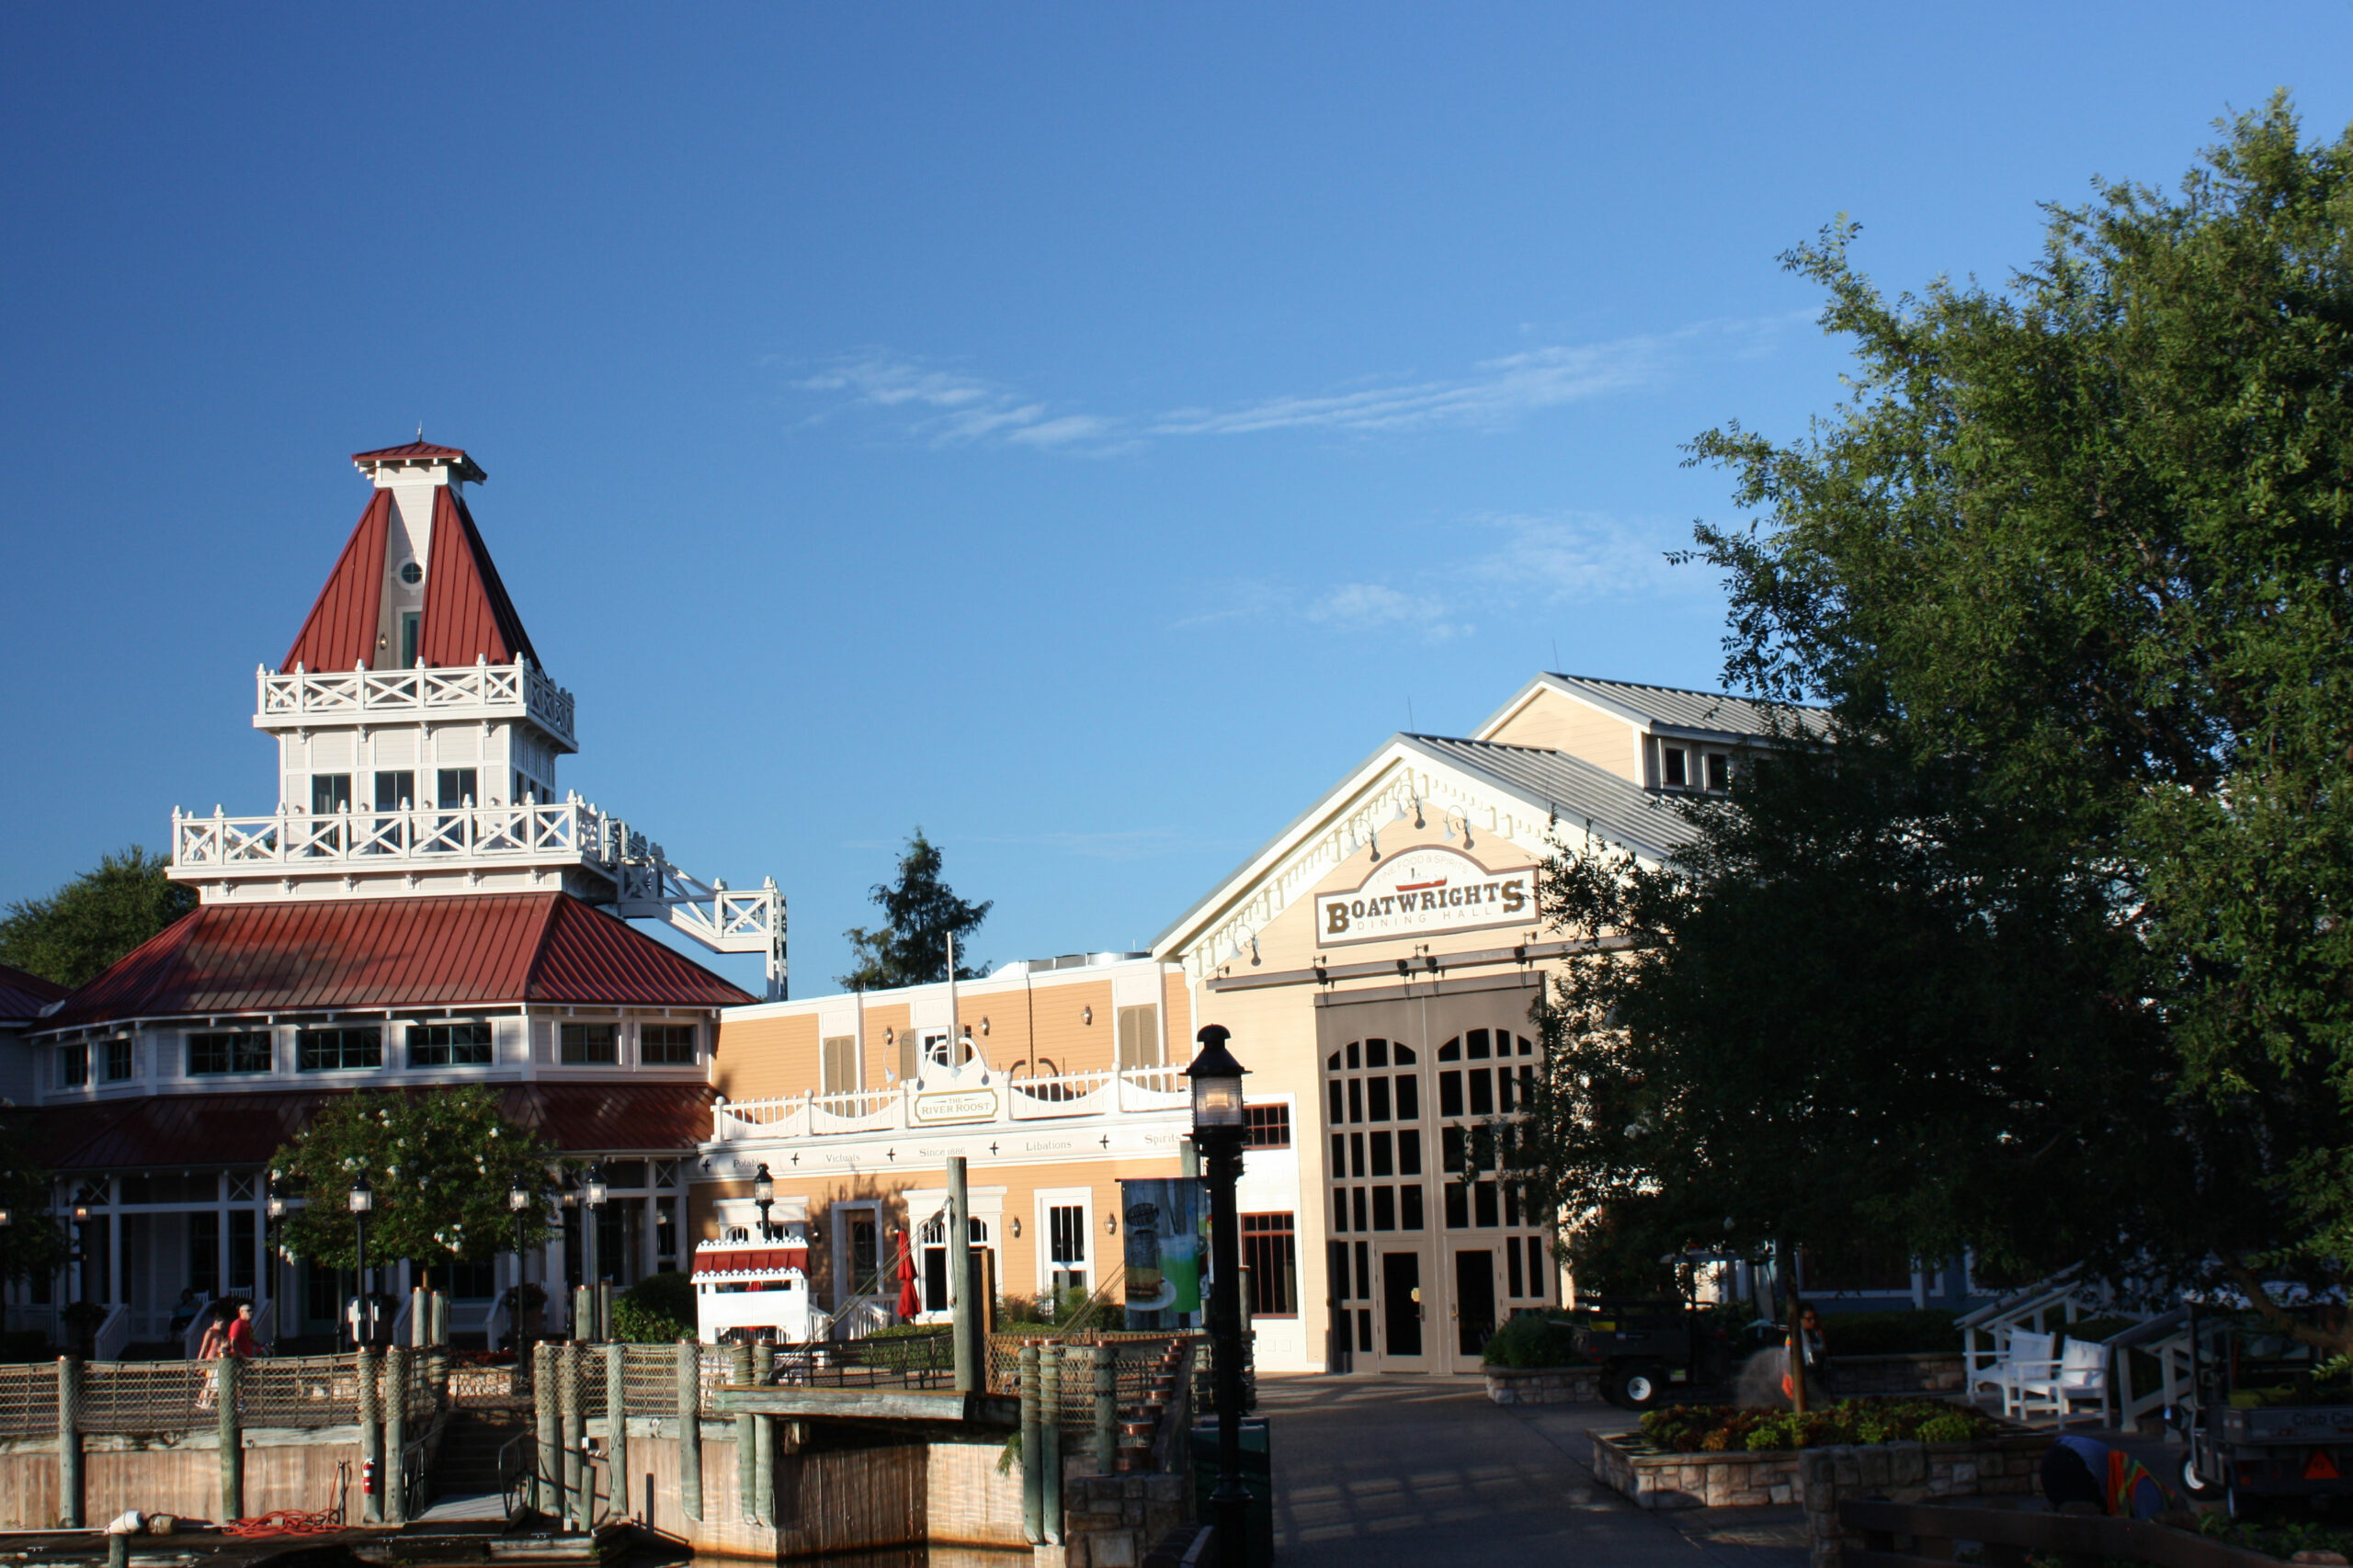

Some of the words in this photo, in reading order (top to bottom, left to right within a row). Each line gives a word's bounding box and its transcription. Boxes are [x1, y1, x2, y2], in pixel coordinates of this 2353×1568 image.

[1396, 855, 1424, 869] FOOD
[1426, 855, 1432, 863] &
[1434, 855, 1469, 874] SPIRITS
[1326, 879, 1525, 935] BOATWRIGHTS
[1357, 914, 1427, 930] DINING
[1443, 906, 1493, 920] HALL
[922, 1105, 953, 1115] RIVER
[956, 1102, 990, 1113] ROOST
[733, 1158, 767, 1168] Potabl
[825, 1153, 860, 1163] Victuals
[919, 1147, 945, 1157] Since
[1026, 1140, 1072, 1152] Libations
[1144, 1132, 1180, 1145] Spirits
[2293, 1412, 2326, 1426] Club
